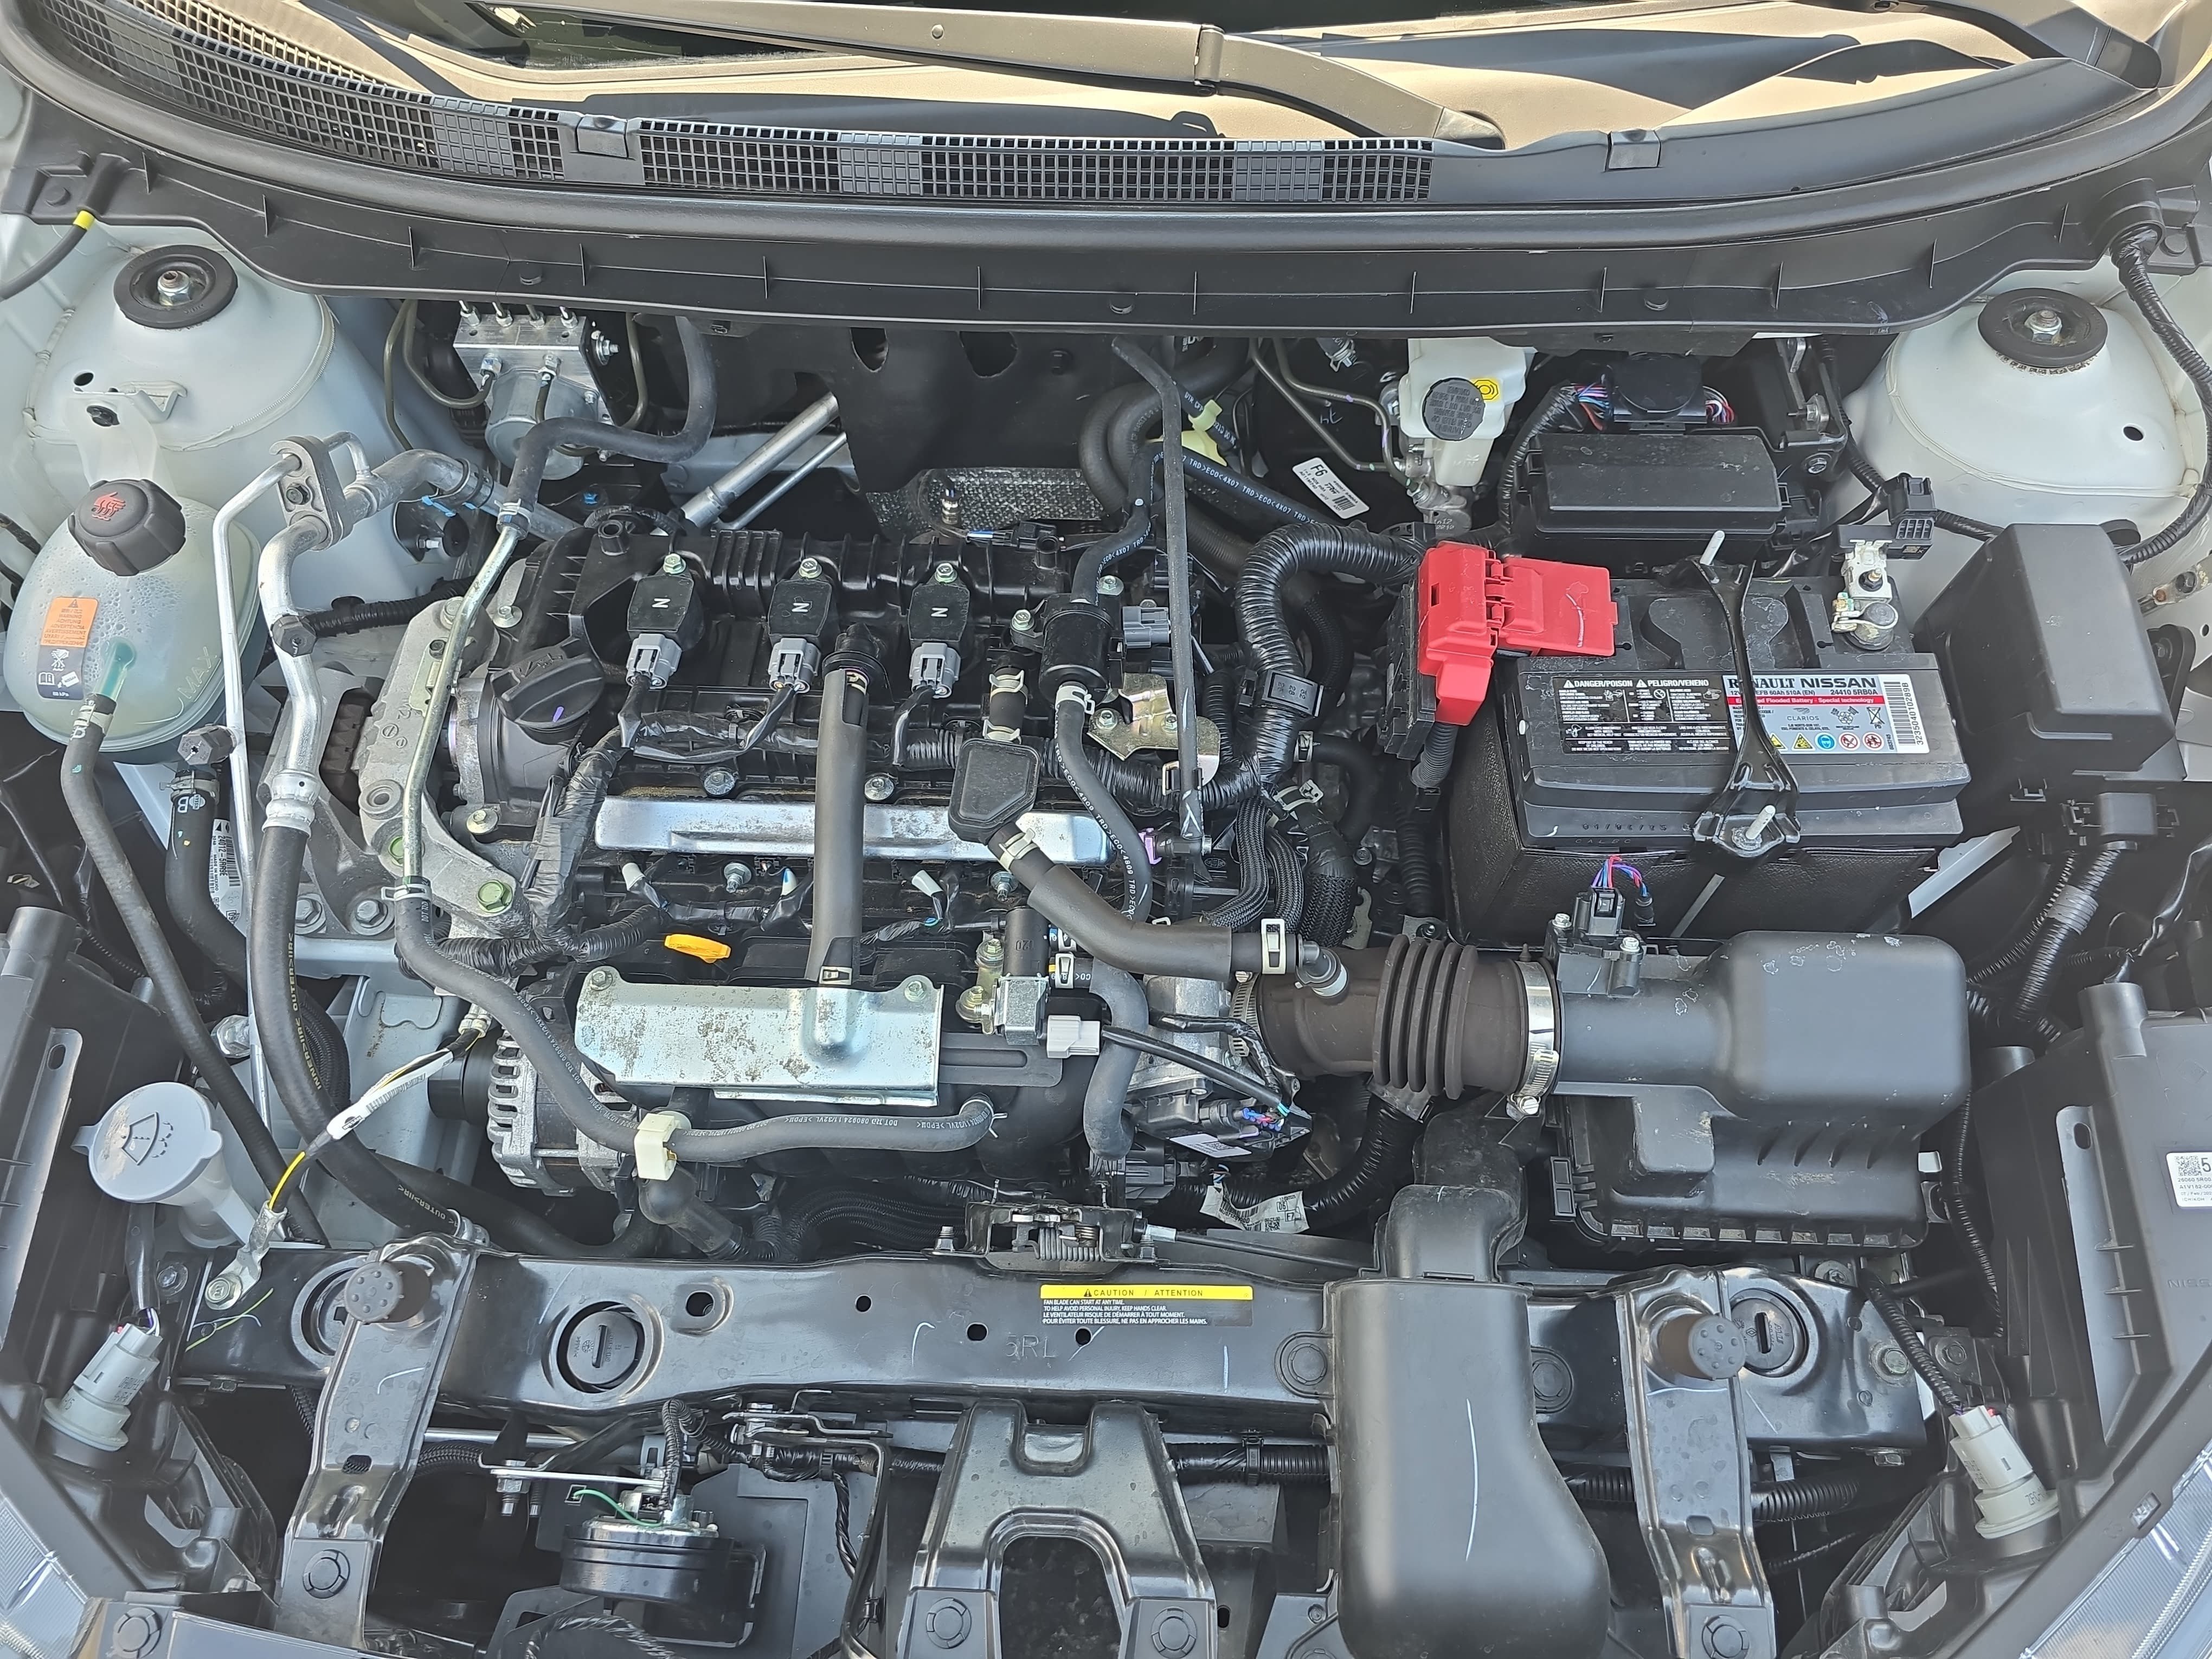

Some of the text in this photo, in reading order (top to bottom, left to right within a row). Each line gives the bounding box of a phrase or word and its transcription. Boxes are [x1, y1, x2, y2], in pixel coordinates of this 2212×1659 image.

[1310, 464, 1328, 477] F6
[1574, 679, 1633, 687] DANGER/POISON
[1728, 677, 1877, 689] RNAULT NISSAN
[1791, 697, 1813, 705] Battery
[1817, 697, 1840, 705] Special
[1841, 697, 1874, 705] technology
